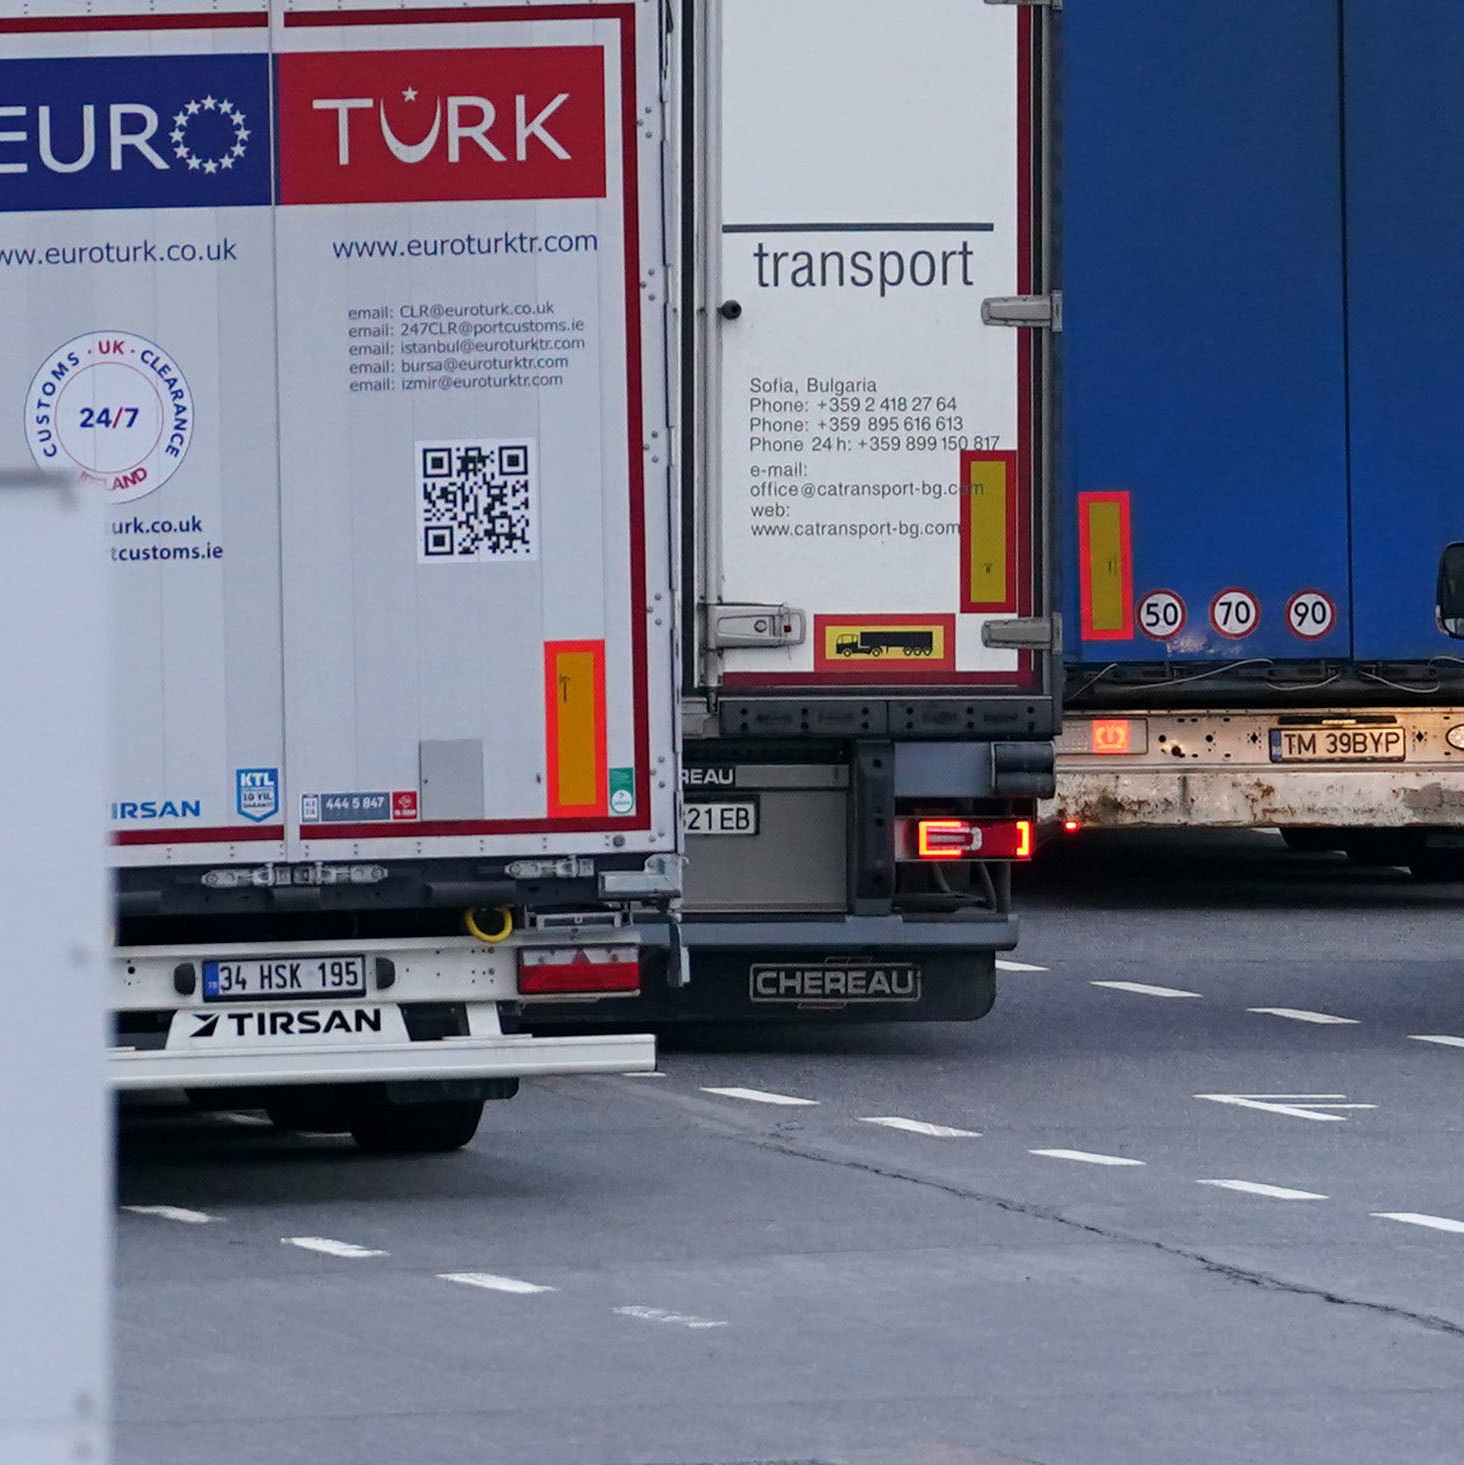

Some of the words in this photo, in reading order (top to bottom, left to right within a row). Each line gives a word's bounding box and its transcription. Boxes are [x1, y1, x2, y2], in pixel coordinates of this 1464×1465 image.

[332, 231, 599, 259] www.euroturktr.com
[752, 240, 974, 298] transport
[348, 308, 395, 321] email:
[399, 300, 555, 320] CLR@euroturk.co.uk
[348, 324, 395, 339] email:
[400, 318, 585, 337] 247CLR@portcustoms.ie
[98, 339, 126, 355] UK
[349, 343, 395, 357] email:
[401, 336, 586, 355] istanbul@euroturktr.com
[349, 361, 396, 375] email:
[401, 355, 569, 374] bursa@euroturktr.com
[350, 380, 396, 393] email:
[402, 373, 564, 392] izmir@euroturktr.com
[749, 377, 799, 396] Sofia,
[806, 377, 878, 396] Bulgaria
[35, 351, 82, 458] CUSTOMS
[140, 349, 189, 459] CLEARANCE
[749, 398, 809, 413] Phone:
[817, 397, 861, 413] +359
[865, 397, 876, 412] 2
[879, 397, 907, 412] 418
[911, 396, 932, 412] 27
[935, 396, 958, 412] 64
[78, 406, 140, 430] 24/7
[749, 418, 809, 433] Phone:
[817, 417, 861, 432] +359
[867, 417, 899, 432] 895
[903, 416, 932, 432] 616
[935, 416, 964, 432] 613
[749, 437, 805, 453] Phone
[811, 437, 833, 452] 24
[836, 436, 852, 452] h:
[857, 436, 902, 452] +359
[905, 436, 937, 452] 899
[941, 435, 969, 452] 150
[973, 435, 1001, 451] 817
[749, 462, 808, 478] e-mail:
[750, 504, 790, 518] web:
[112, 515, 204, 535] urk.co.uk
[750, 520, 962, 540] www.catransport-bg.com
[110, 541, 225, 562] tcustoms.ie
[1145, 602, 1179, 628] 50
[1219, 600, 1251, 626] 70
[1293, 600, 1327, 627] 90
[1284, 732, 1317, 755] TM
[240, 772, 275, 786] KTL
[679, 768, 734, 785] REAU
[111, 799, 202, 820] IRSAN
[326, 797, 349, 811] 444
[352, 797, 361, 809] 5
[220, 965, 248, 992] 34
[260, 962, 303, 990] HSK
[318, 960, 359, 988] 195
[755, 969, 915, 996] CHEREAU
[227, 1008, 382, 1037] TIRSAN
